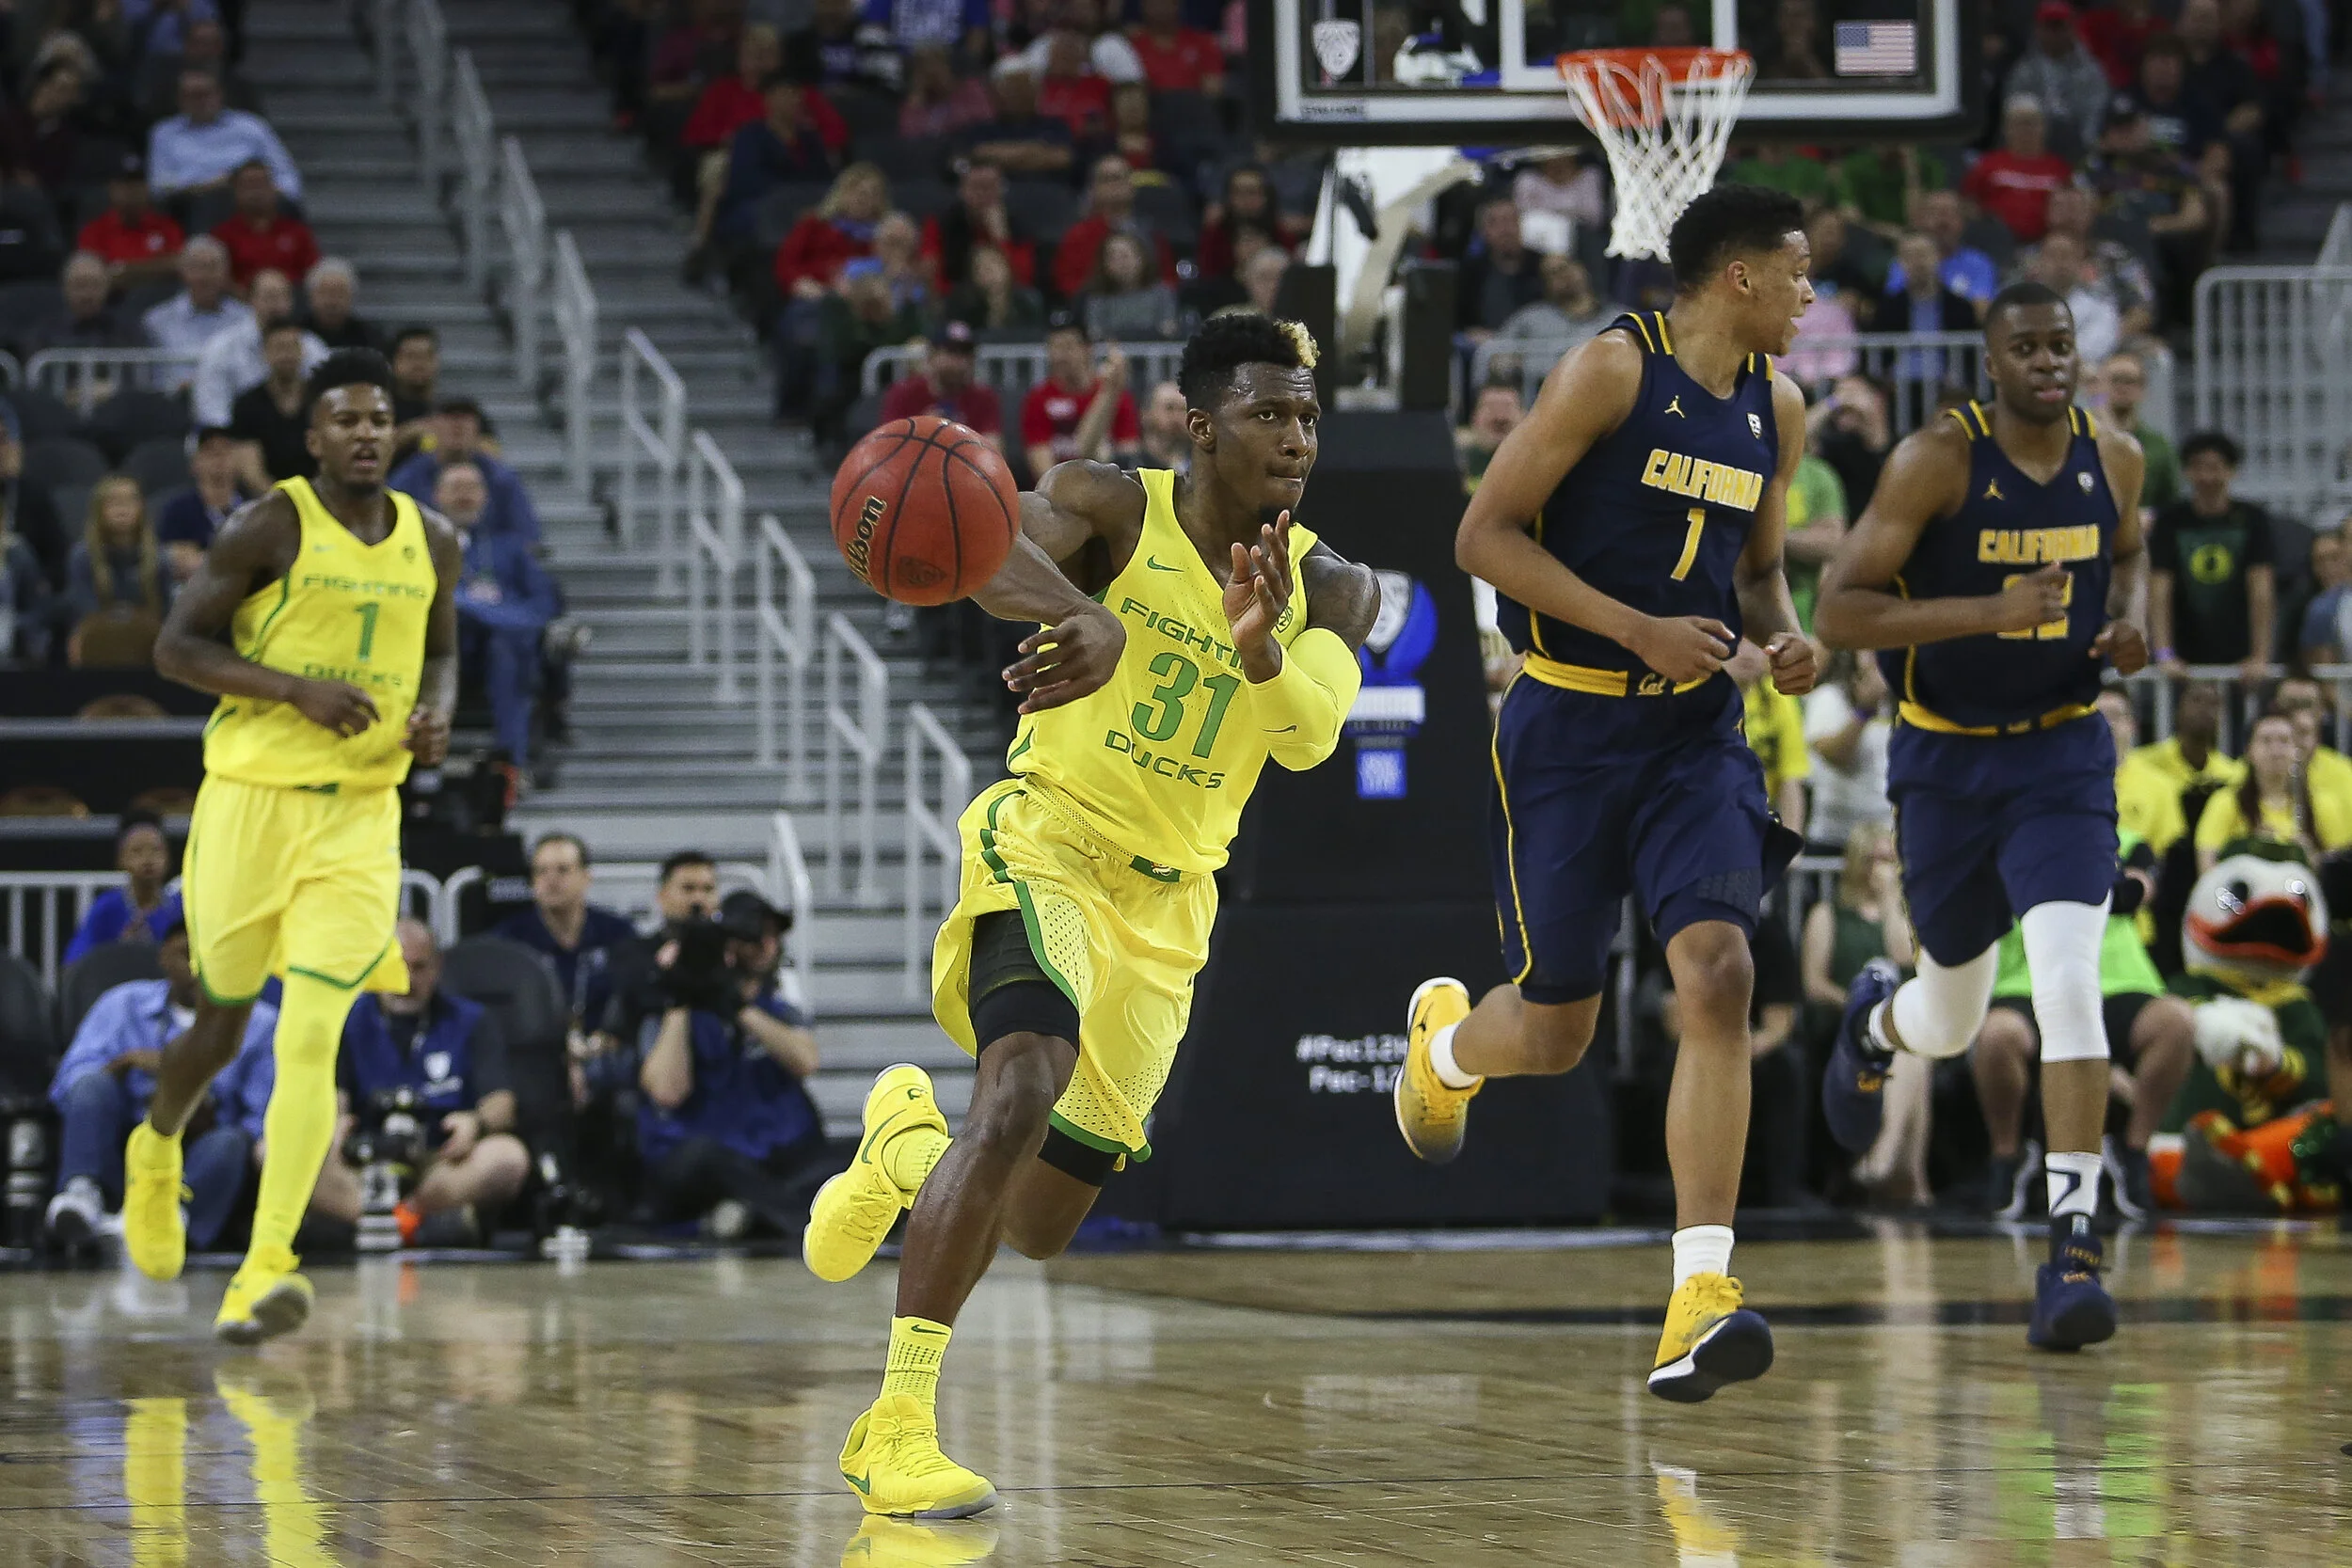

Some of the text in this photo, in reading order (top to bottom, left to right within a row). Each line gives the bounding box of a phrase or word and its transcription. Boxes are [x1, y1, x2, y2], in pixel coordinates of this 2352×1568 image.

[1641, 448, 1765, 512] CALIFORNIA
[846, 494, 888, 587] ilson
[1670, 507, 1707, 581] 1
[1978, 523, 2100, 564] CALIFORNIA
[353, 601, 380, 663] 1
[1120, 596, 1244, 671] FIGHTI
[1131, 652, 1241, 759] 31
[1104, 729, 1226, 789] DUCKS
[1295, 1034, 1407, 1062] #Pac12
